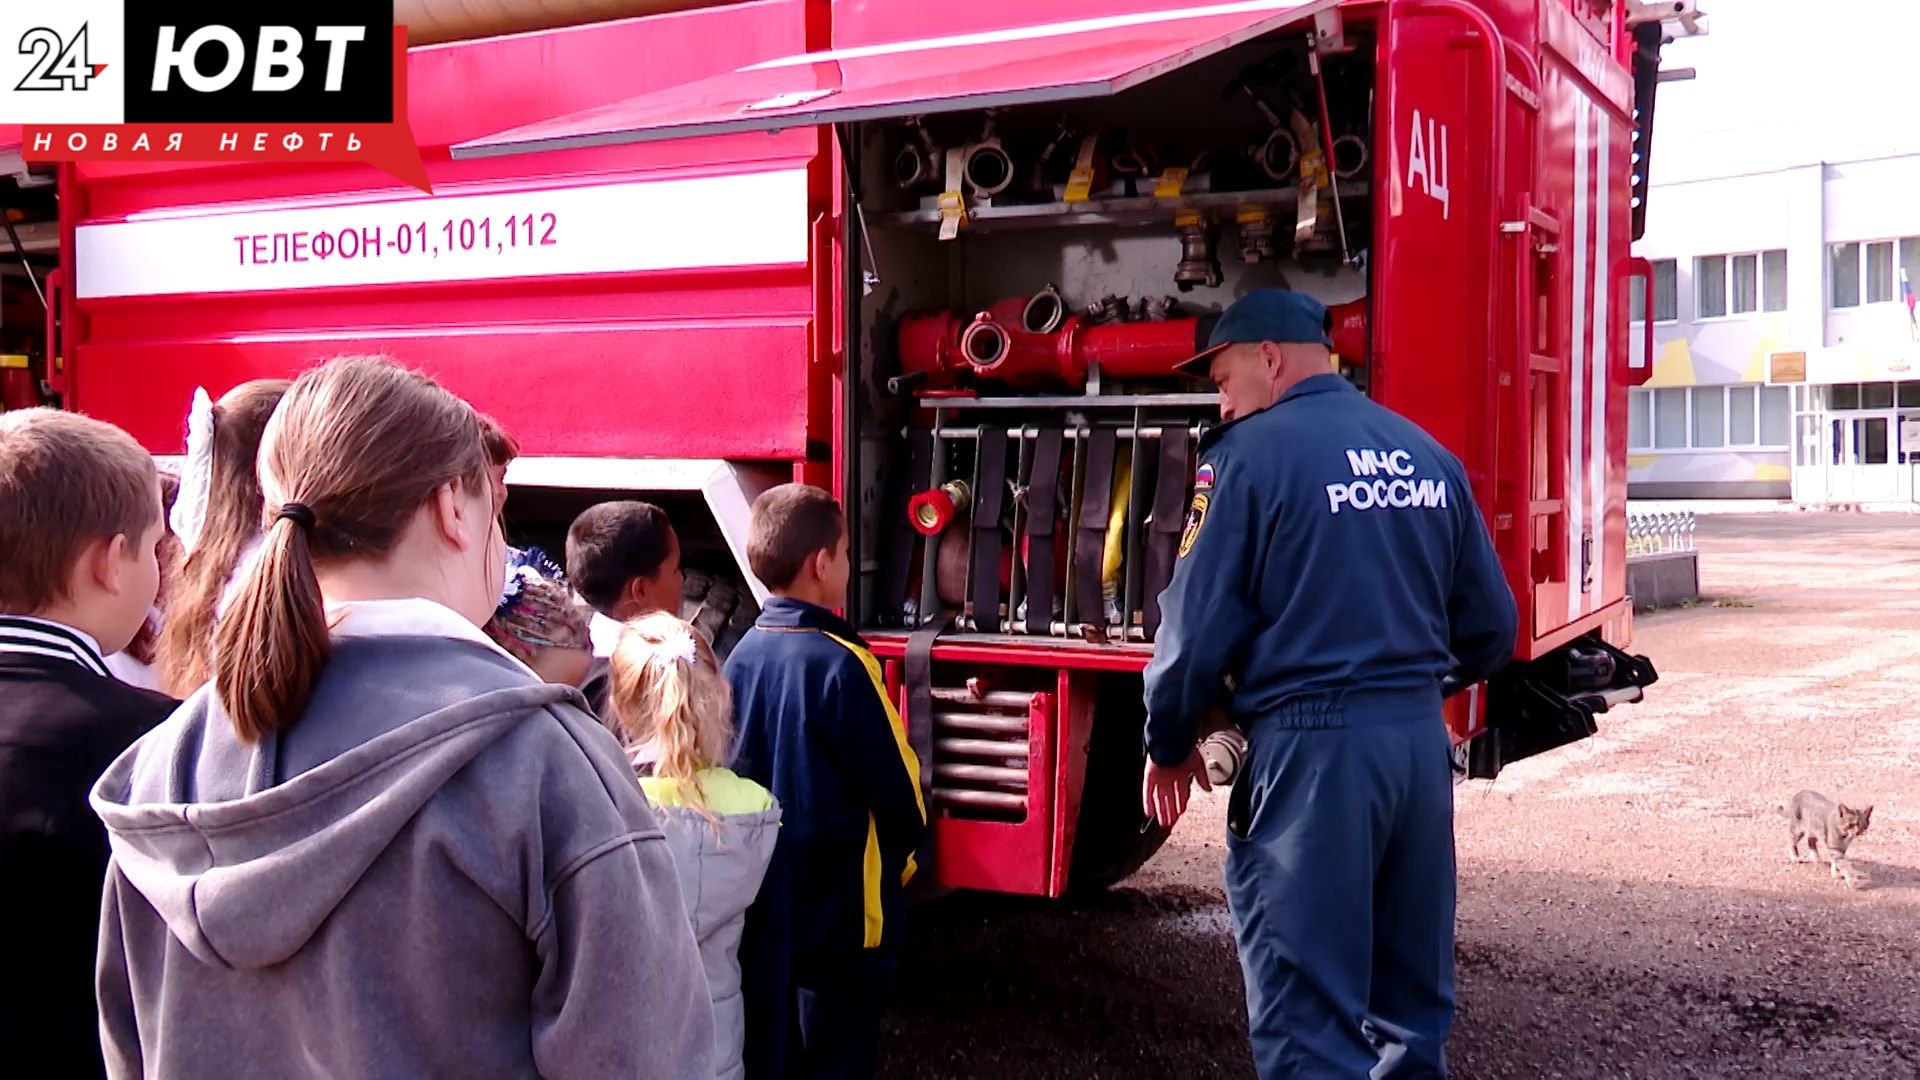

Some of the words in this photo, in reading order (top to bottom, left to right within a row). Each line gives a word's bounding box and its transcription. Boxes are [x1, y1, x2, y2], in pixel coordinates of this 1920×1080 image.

[1407, 108, 1449, 220] АЦ
[233, 211, 558, 266] ТЕЛЕФОН-01,101,112
[1345, 448, 1415, 476] МЧС
[1325, 479, 1447, 513] РОССИИ
